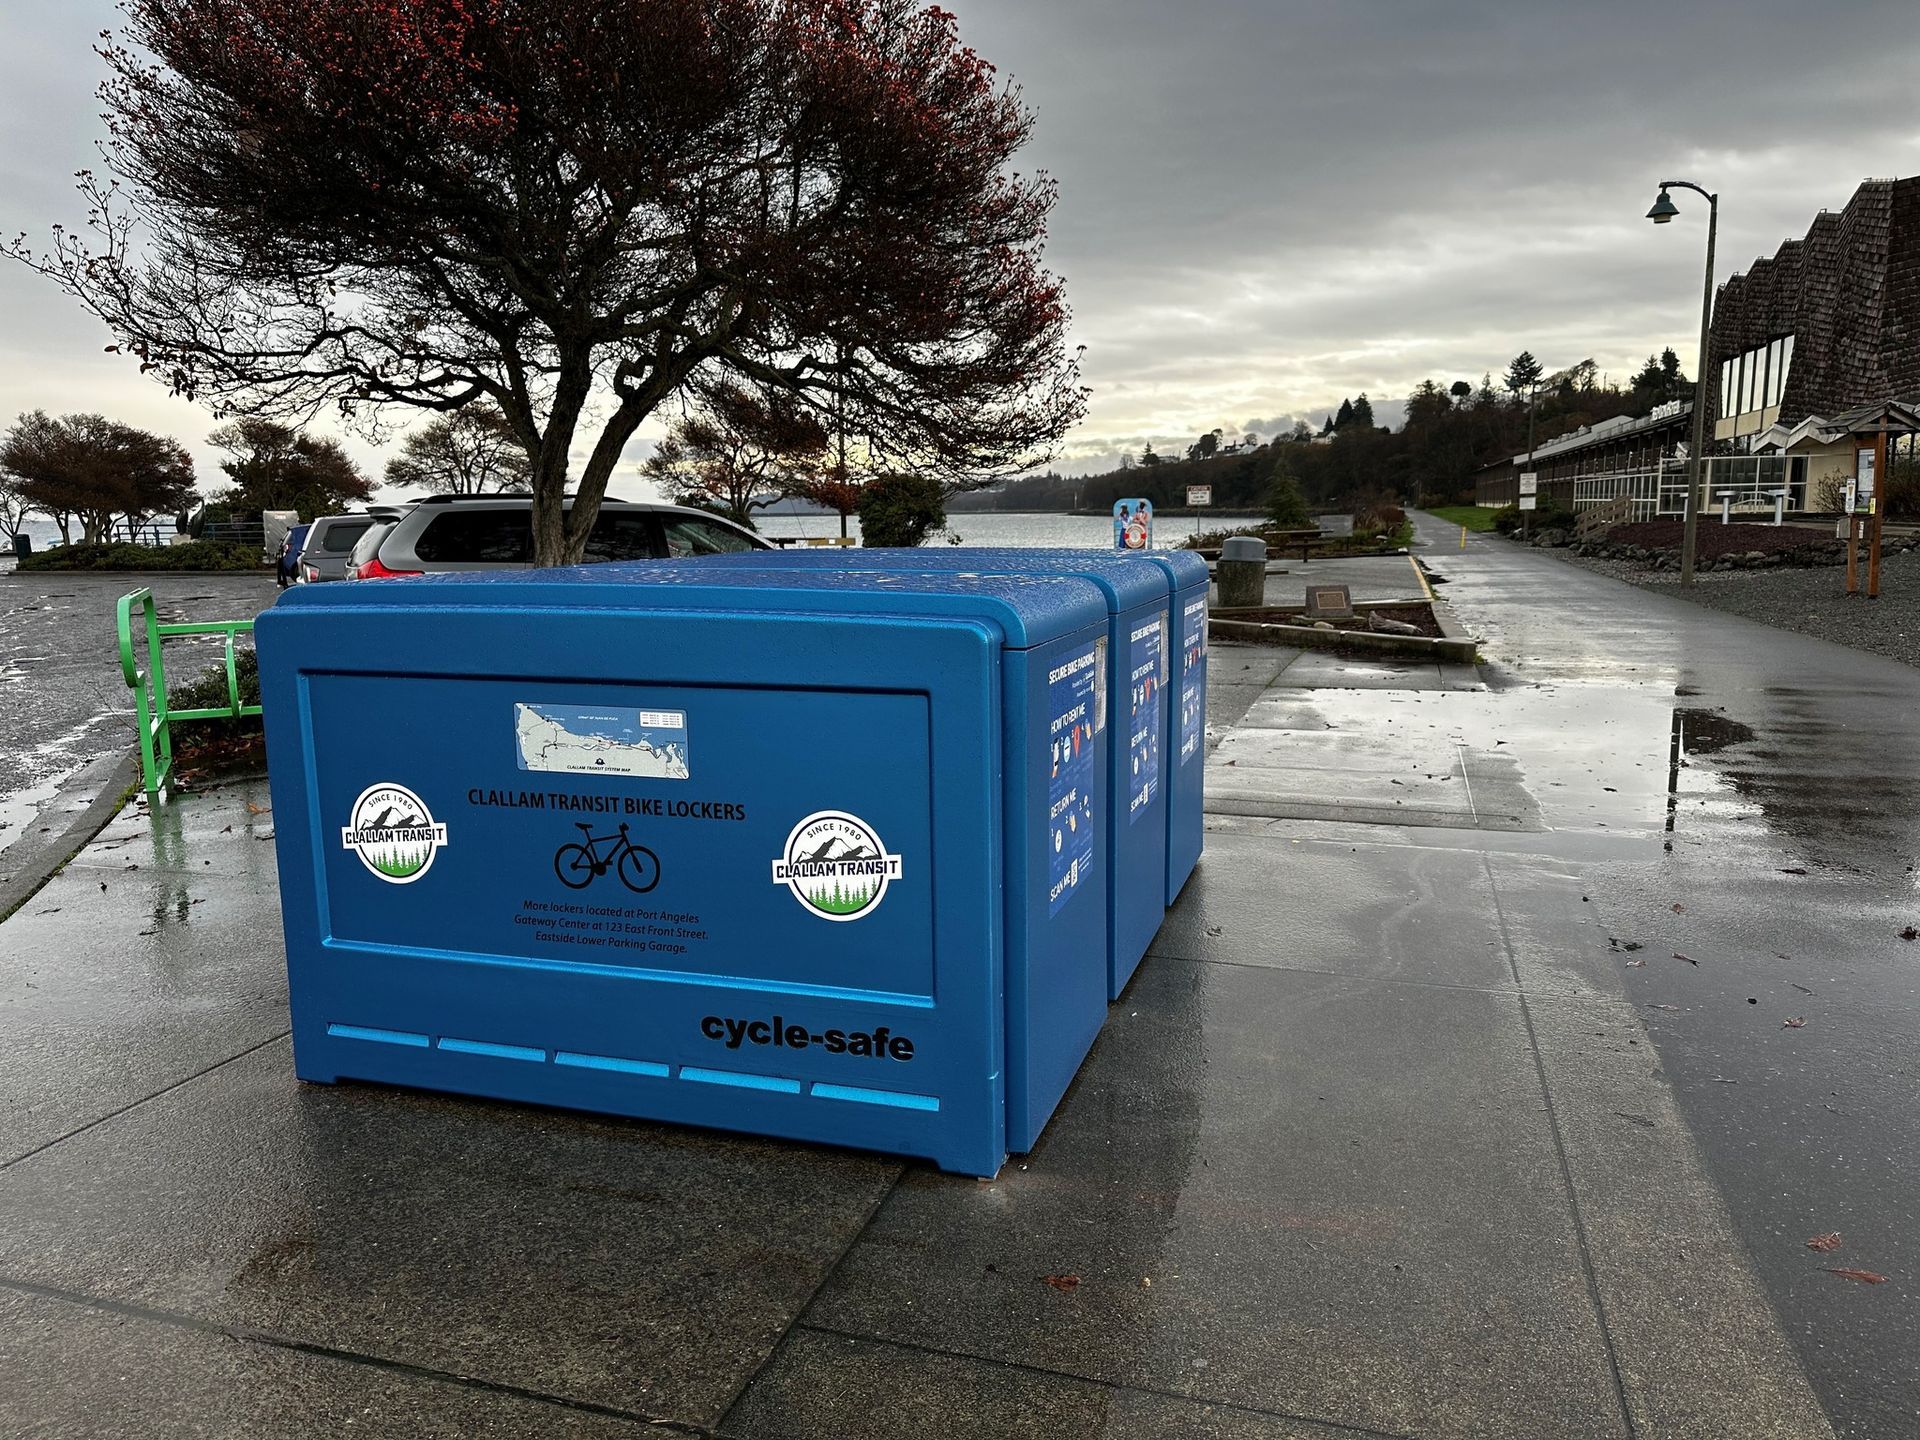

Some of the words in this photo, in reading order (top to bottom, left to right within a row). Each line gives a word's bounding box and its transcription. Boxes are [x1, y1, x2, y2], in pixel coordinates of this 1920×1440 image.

[1049, 665, 1067, 684] SECURE
[1067, 660, 1077, 674] BIKE
[1077, 652, 1094, 669] PARKING
[368, 794, 390, 808] SINCE
[394, 795, 413, 810] 1980
[468, 789, 544, 808] CLALLAM
[548, 794, 620, 812] TRANSIT
[624, 798, 662, 816] BIKE
[668, 800, 746, 820] LOCKERS
[346, 830, 394, 844] CLALLAM
[395, 828, 444, 842] TRANSIT
[806, 822, 834, 838] SINCE
[839, 824, 862, 840] 1980
[776, 862, 836, 878] CLALLAM
[838, 860, 898, 876] TRANSIT
[1050, 877, 1063, 903] SCAN
[1063, 869, 1070, 888] ME
[523, 900, 548, 911] More
[550, 902, 583, 914] lockers
[586, 904, 622, 918] located
[624, 908, 634, 918] at
[637, 908, 658, 920] Port
[660, 912, 700, 924] Angeles
[514, 914, 556, 928] Gateway
[559, 917, 590, 930] Center
[592, 920, 603, 931] at
[606, 922, 622, 932] 123
[625, 924, 646, 935] East
[648, 926, 674, 937] Front
[676, 928, 709, 940] Street.
[535, 931, 576, 944] Eastside
[577, 935, 606, 946] Lower
[608, 937, 646, 952] Parking
[648, 940, 688, 954] Garage.
[701, 1015, 915, 1062] cycle-safe
